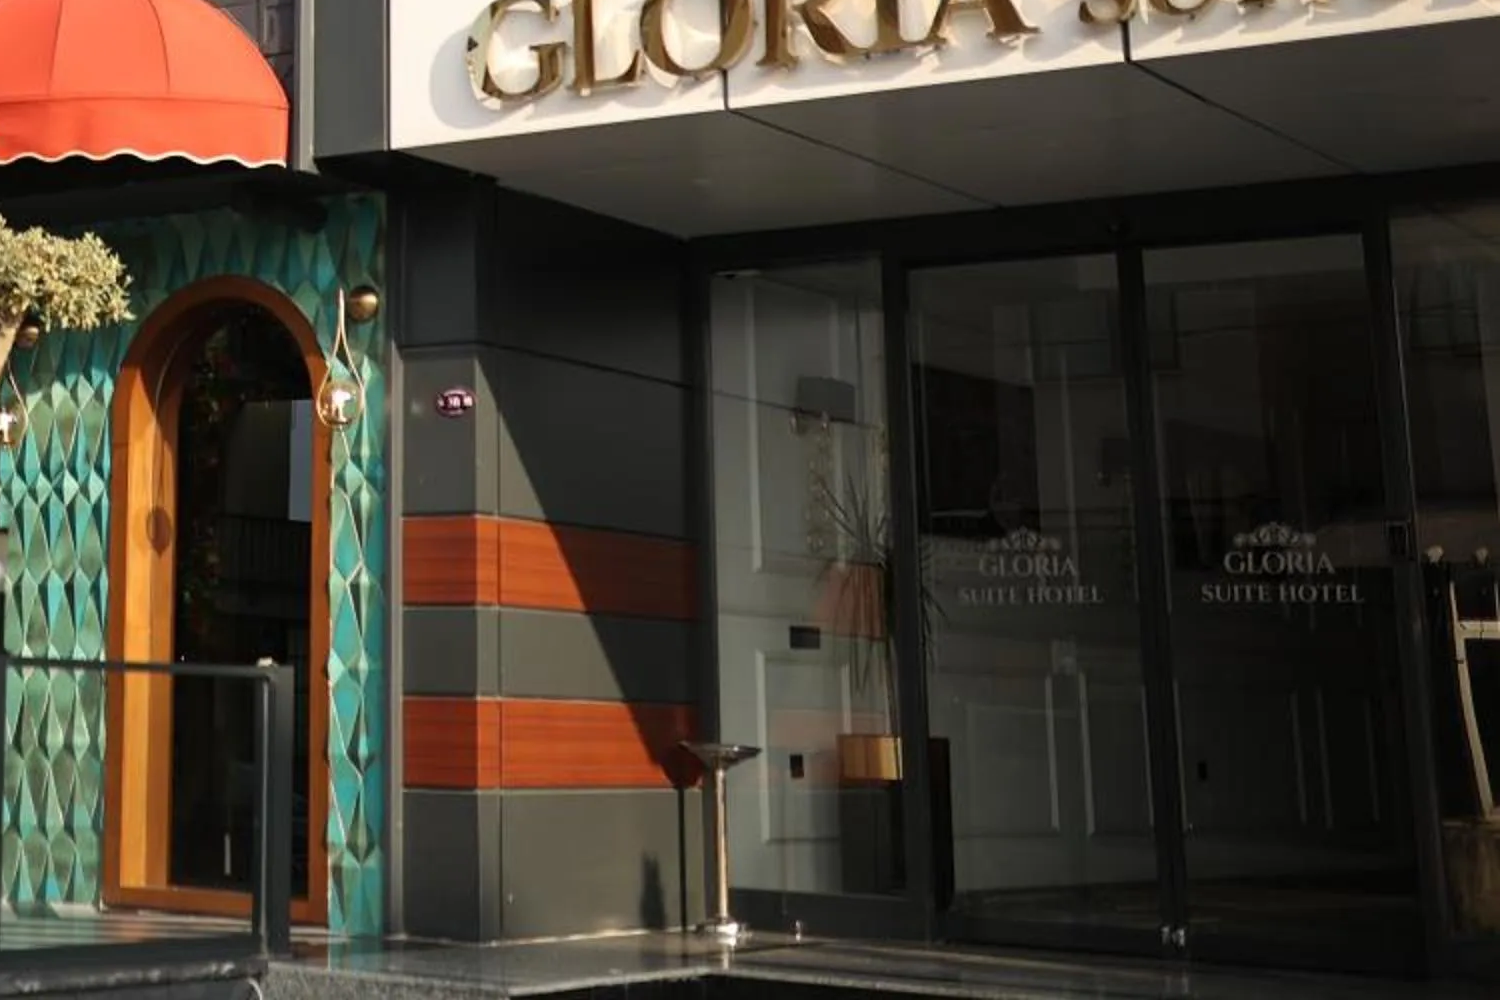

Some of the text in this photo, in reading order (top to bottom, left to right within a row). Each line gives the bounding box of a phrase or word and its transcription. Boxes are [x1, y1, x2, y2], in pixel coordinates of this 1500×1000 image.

[978, 554, 1080, 578] GLORIA
[1223, 550, 1336, 576] GLORIA
[959, 584, 1104, 606] SUITE HOTEL
[1201, 583, 1365, 603] SUITE HOTEL
